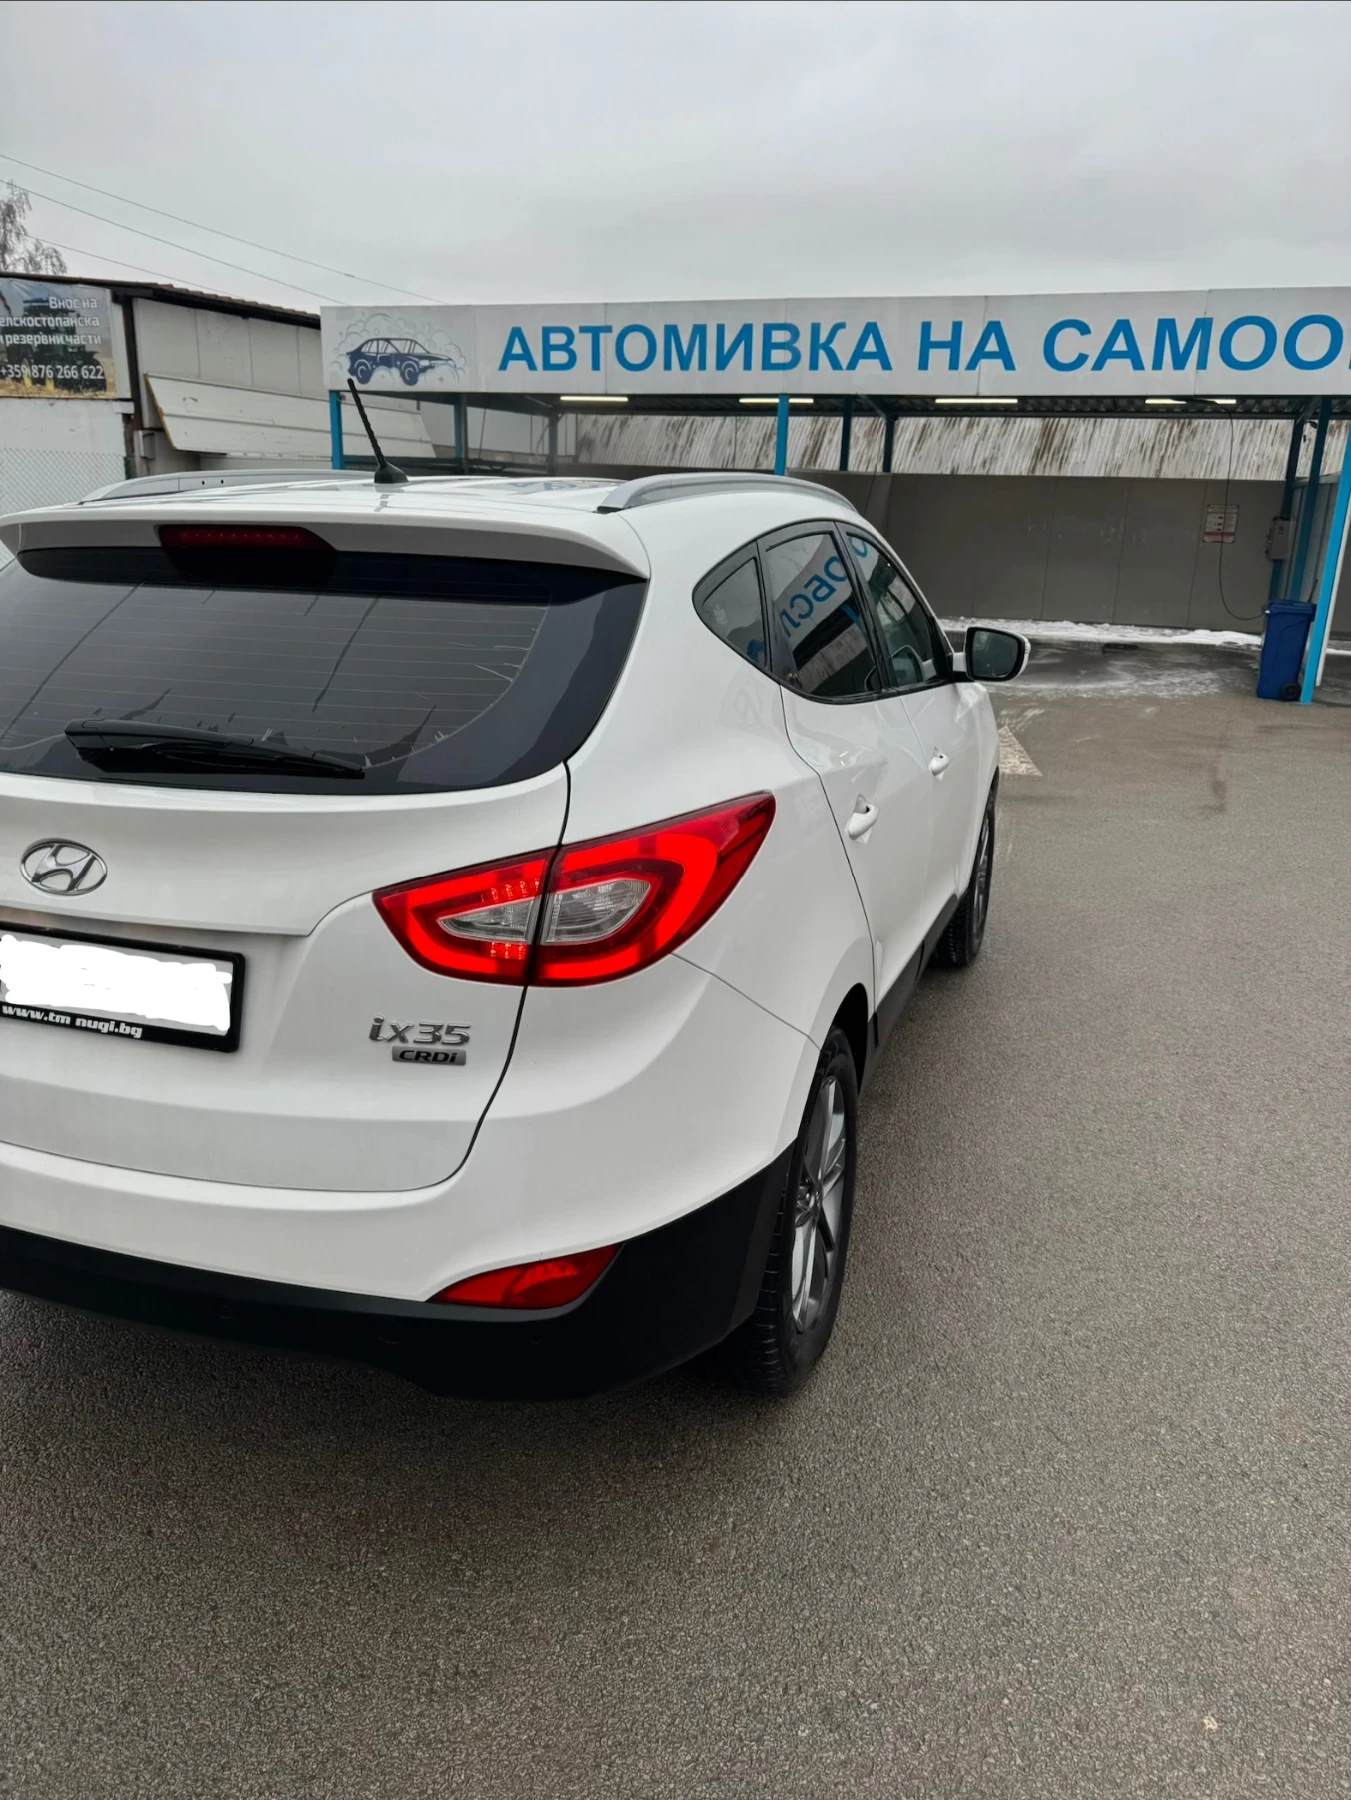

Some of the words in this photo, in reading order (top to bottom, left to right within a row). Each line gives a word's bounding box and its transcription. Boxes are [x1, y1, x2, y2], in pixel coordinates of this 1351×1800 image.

[49, 296, 80, 309] Внос
[82, 299, 98, 309] на
[5, 333, 63, 347] резервни
[65, 335, 102, 345] части
[499, 321, 893, 373] АВТОМИВКА
[917, 320, 1017, 372] НА
[1043, 314, 1351, 372] САМОО
[31, 364, 54, 378] 876
[55, 365, 79, 379] 266
[80, 365, 105, 379] 622
[75, 1017, 143, 1038] nugi.bg
[369, 1015, 471, 1045] ix35
[399, 1050, 458, 1063] CRDi
